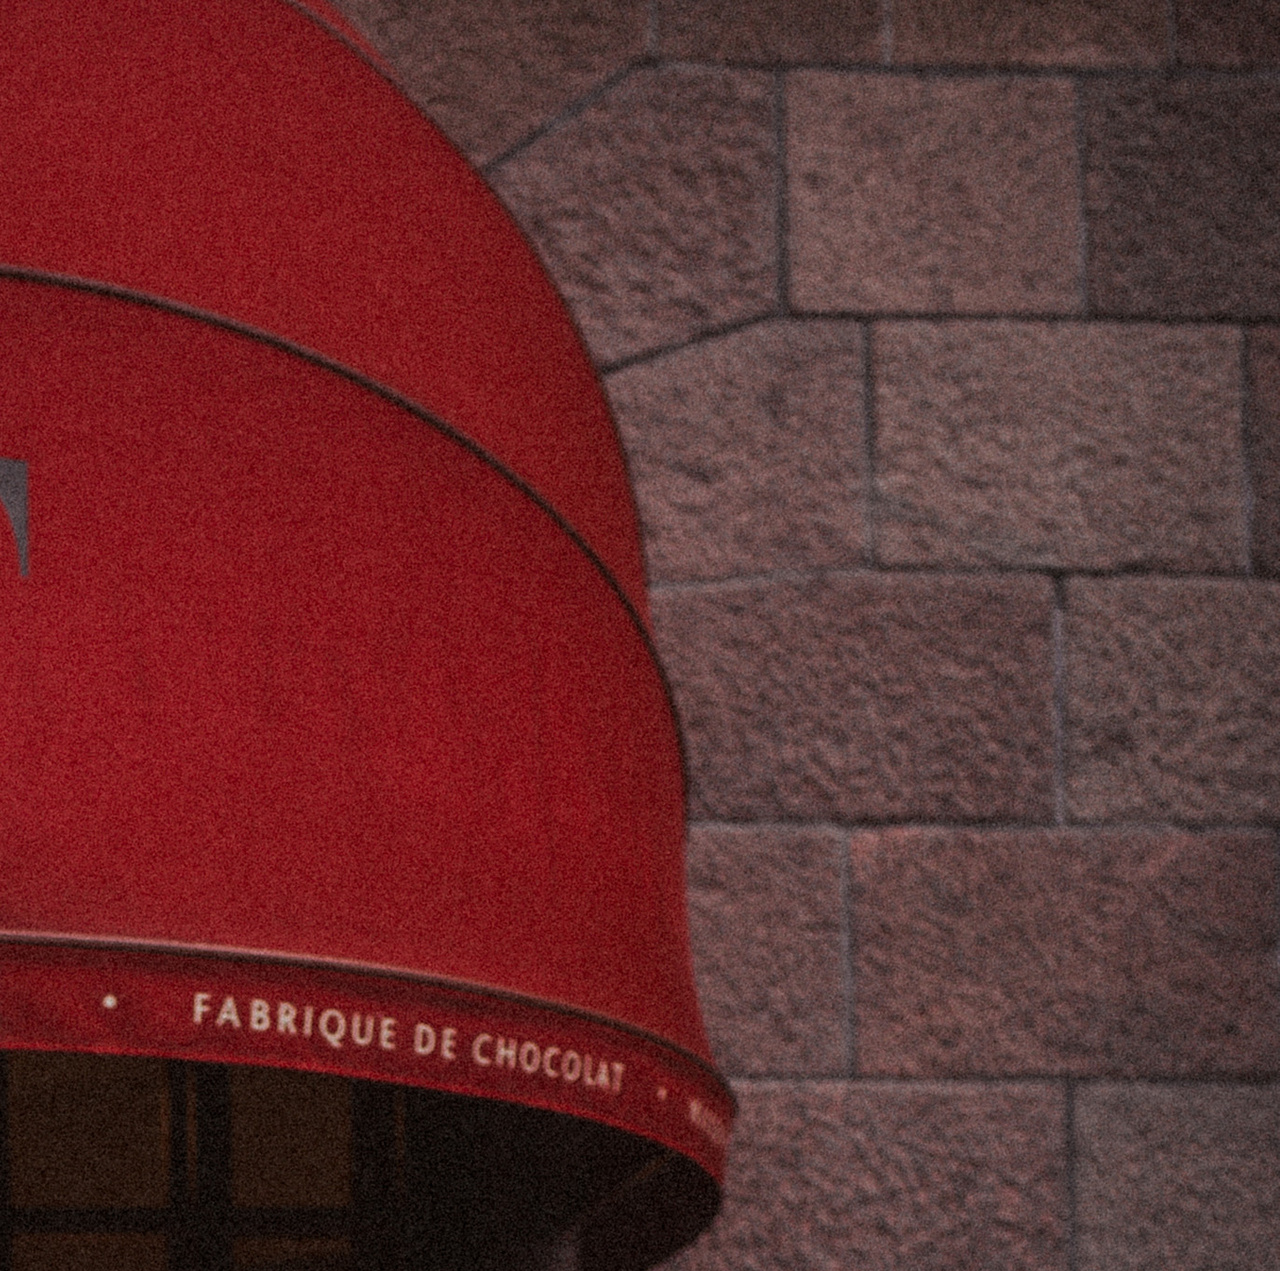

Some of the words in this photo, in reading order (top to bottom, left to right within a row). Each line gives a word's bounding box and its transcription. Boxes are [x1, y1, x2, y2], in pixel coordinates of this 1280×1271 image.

[192, 992, 397, 1050] FABRIQUE
[412, 1022, 458, 1062] DE
[471, 1032, 626, 1092] CHOCOLAT
